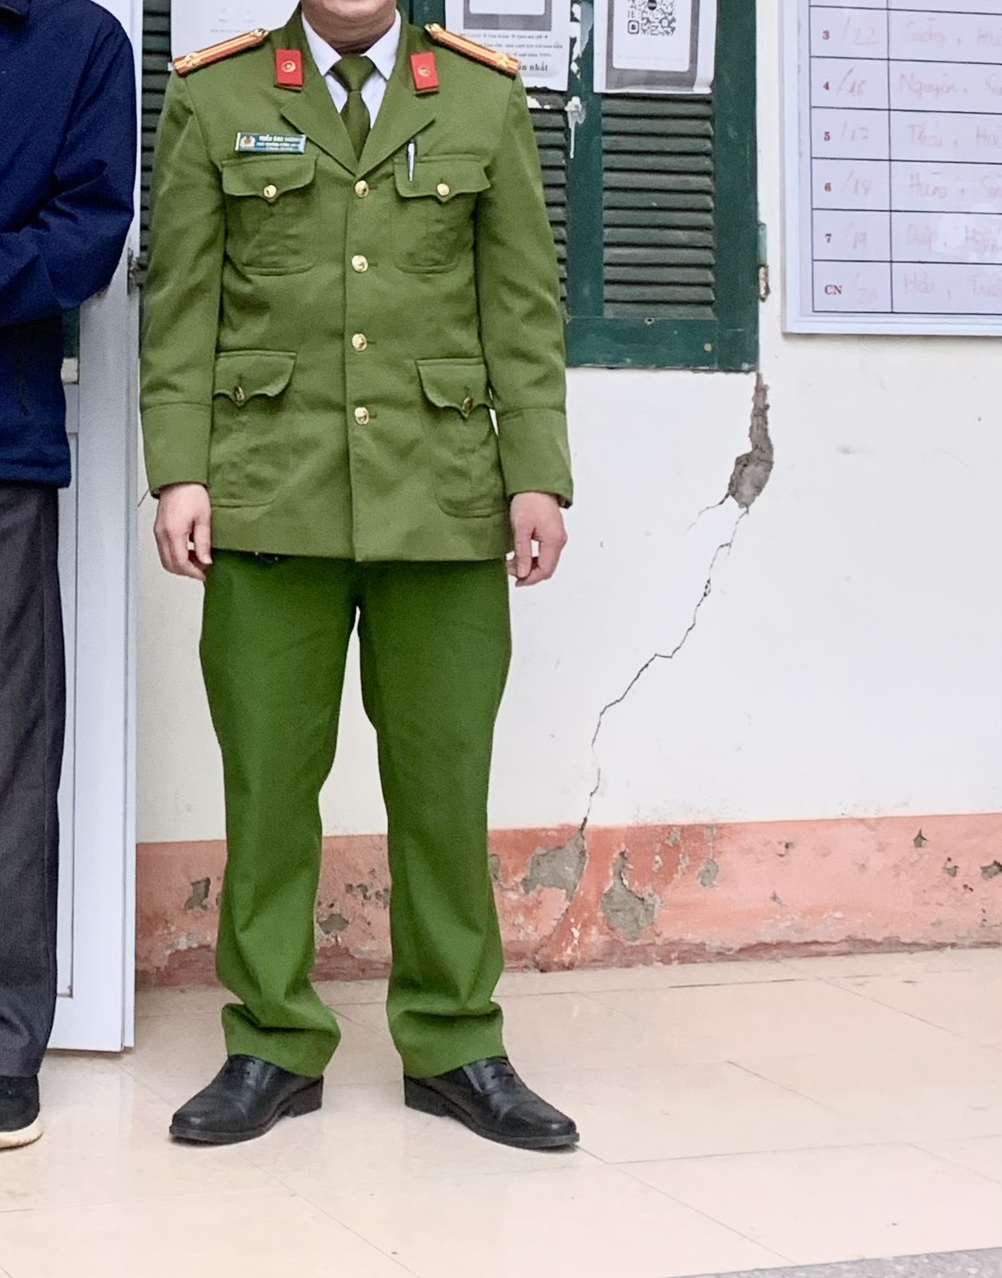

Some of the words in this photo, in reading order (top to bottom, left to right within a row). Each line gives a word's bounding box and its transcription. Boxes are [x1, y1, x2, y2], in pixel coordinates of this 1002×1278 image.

[822, 30, 830, 40] 3
[822, 81, 830, 90] 4
[823, 131, 831, 141] 5
[824, 182, 832, 192] 6
[824, 233, 832, 243] 7
[824, 285, 842, 295] CN
